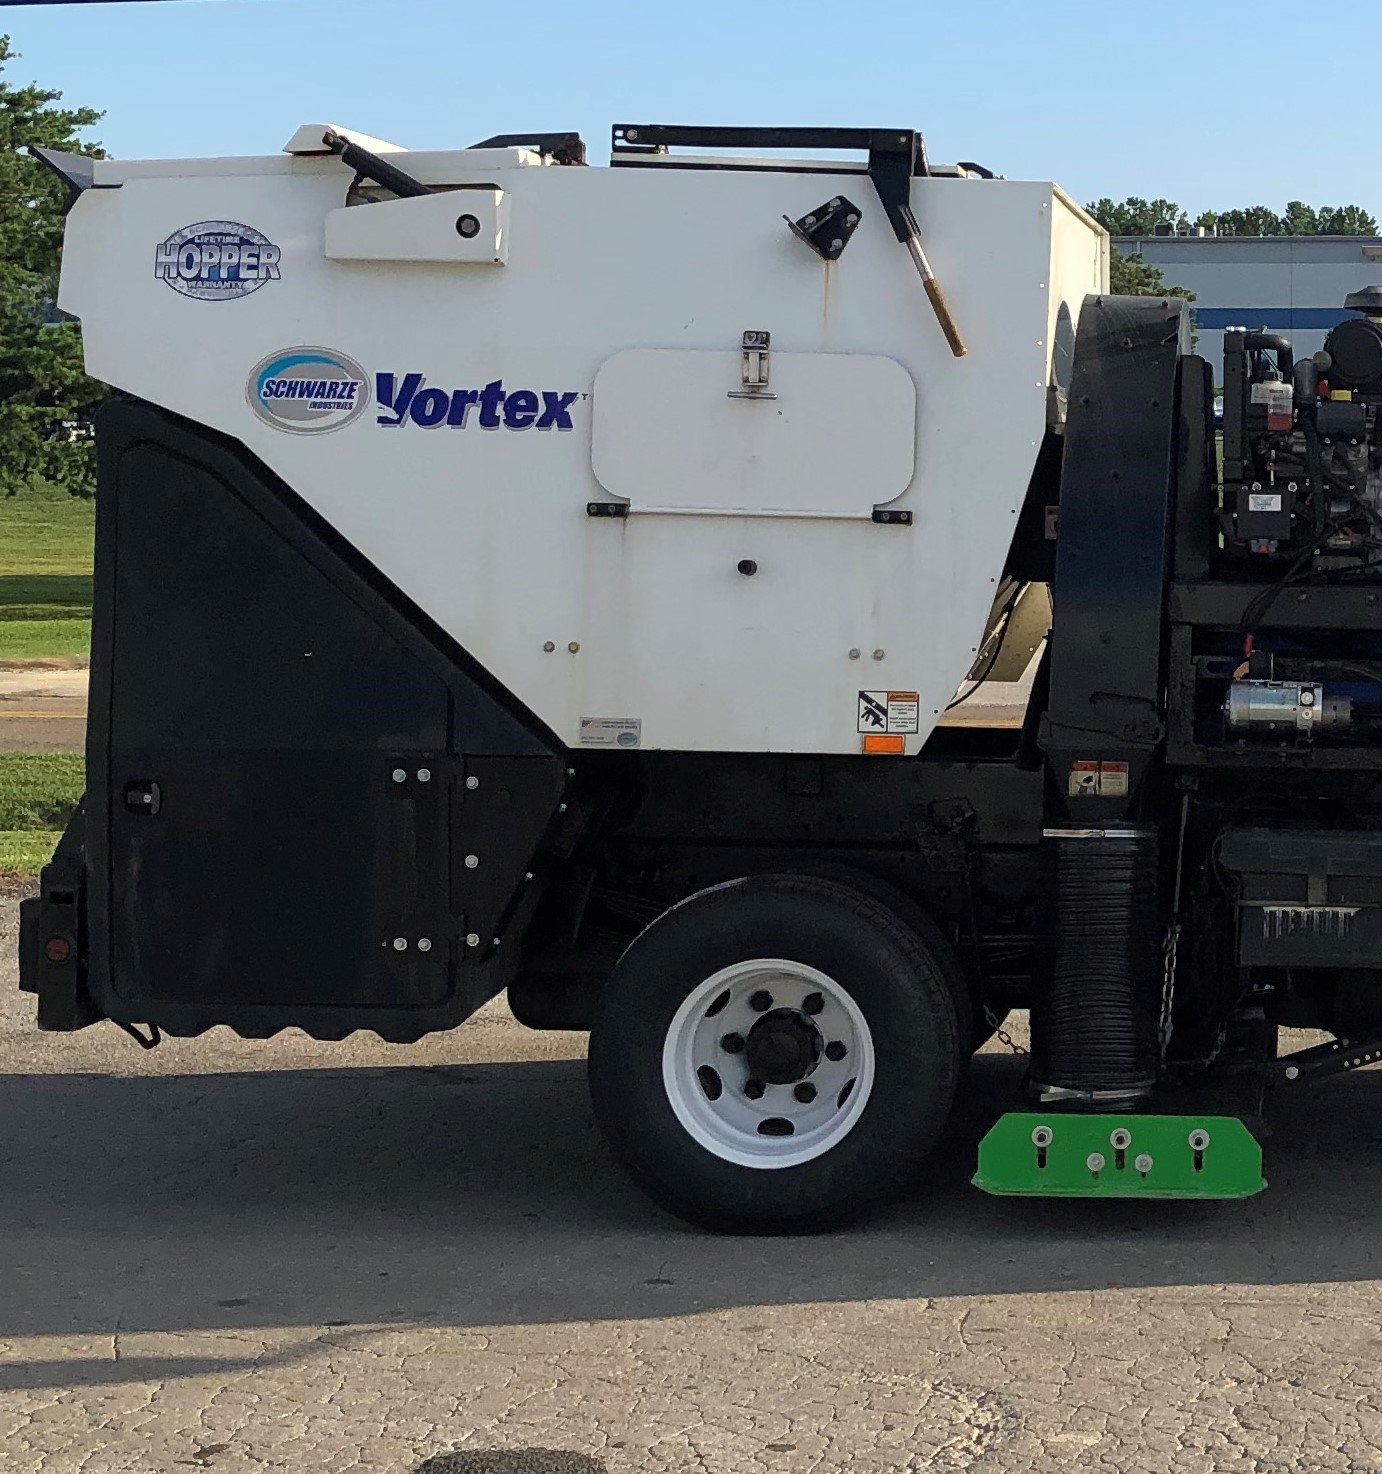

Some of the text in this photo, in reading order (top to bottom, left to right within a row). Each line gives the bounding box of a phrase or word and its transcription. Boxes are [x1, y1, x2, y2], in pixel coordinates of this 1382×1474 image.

[194, 235, 240, 244] LIFETIME
[155, 244, 281, 280] HOPPER
[187, 281, 244, 290] WARRANTY
[262, 379, 359, 400] SCHWARZE
[308, 401, 354, 411] INDUSTRIES
[376, 372, 579, 431] Vortex
